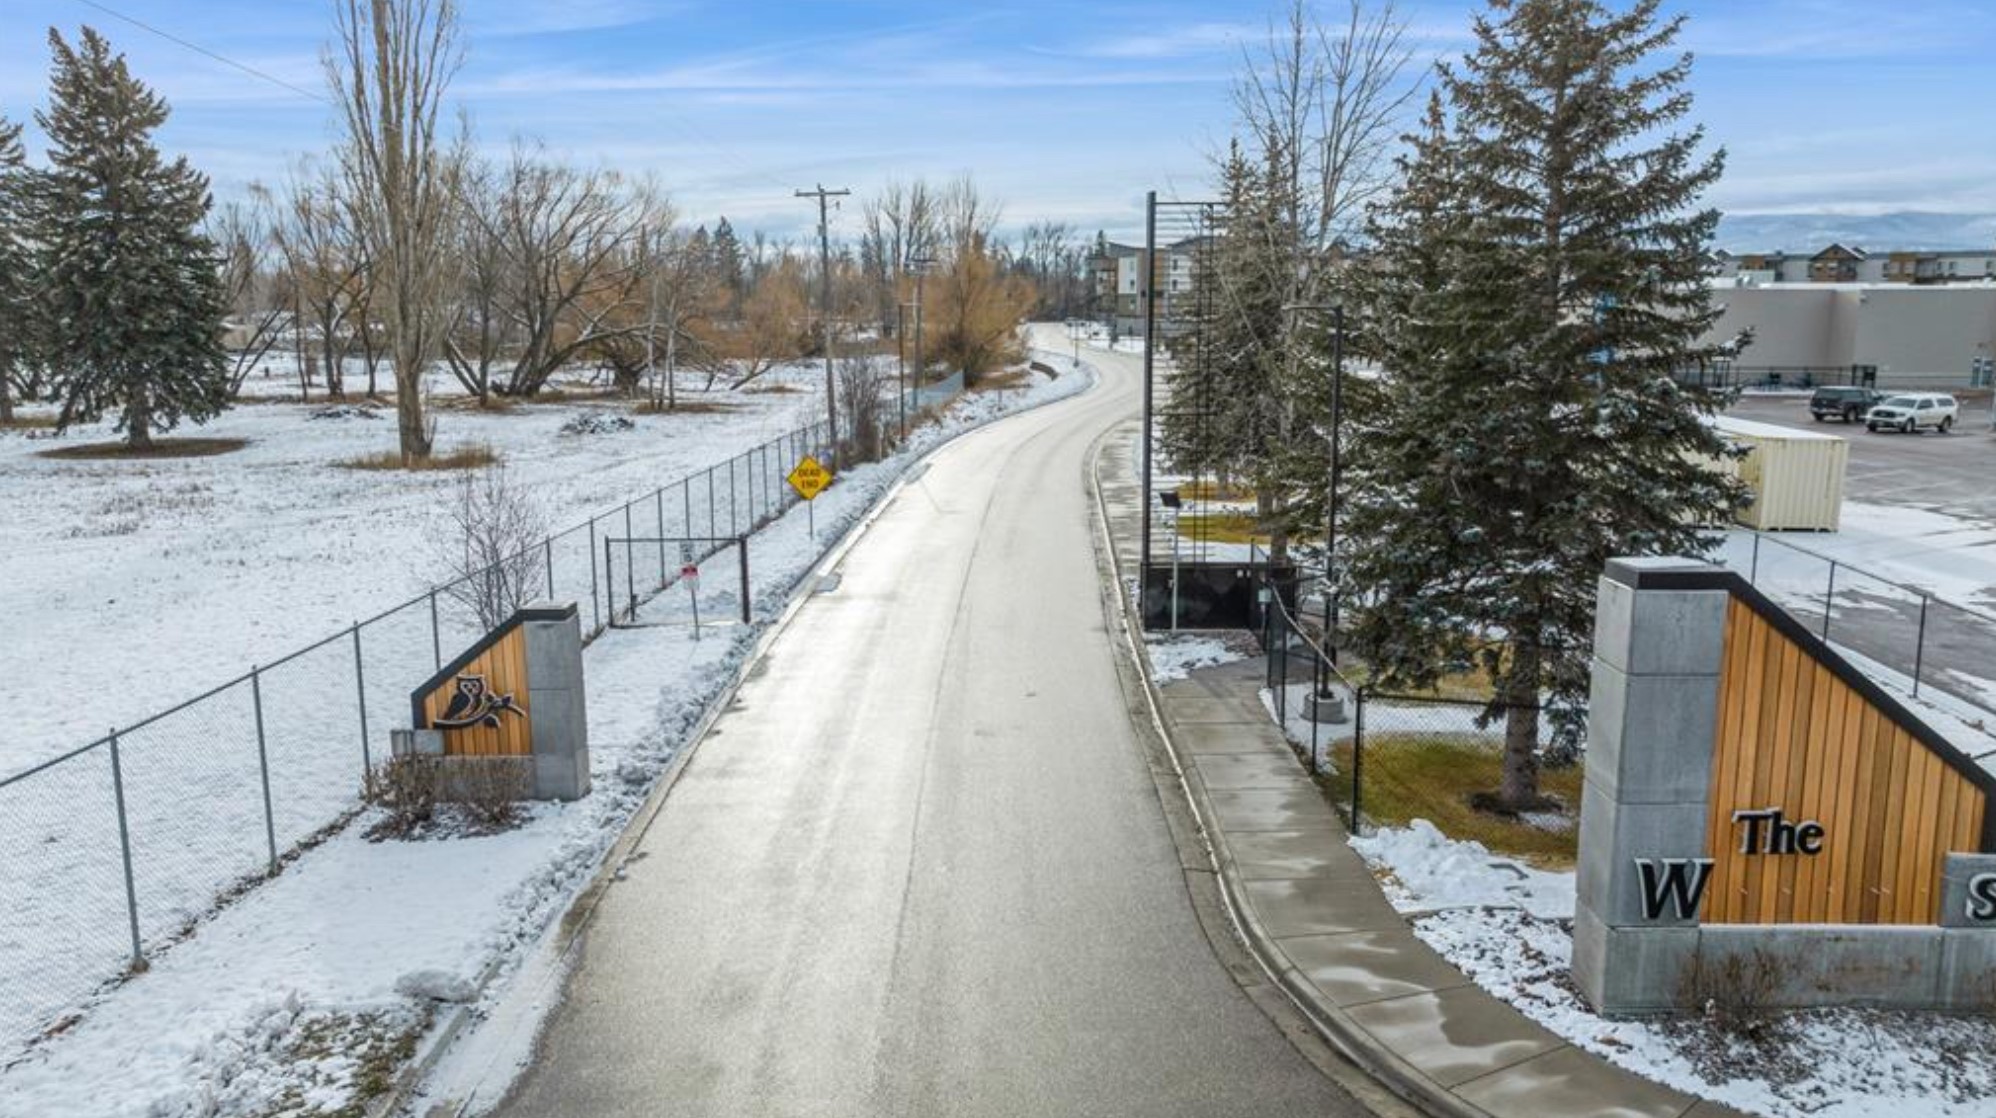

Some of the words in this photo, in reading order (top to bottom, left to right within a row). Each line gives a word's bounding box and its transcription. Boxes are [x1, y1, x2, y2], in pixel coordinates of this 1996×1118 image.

[798, 468, 821, 477] DEAD
[801, 479, 819, 489] END
[1731, 806, 1825, 855] The
[1634, 857, 1716, 920] W
